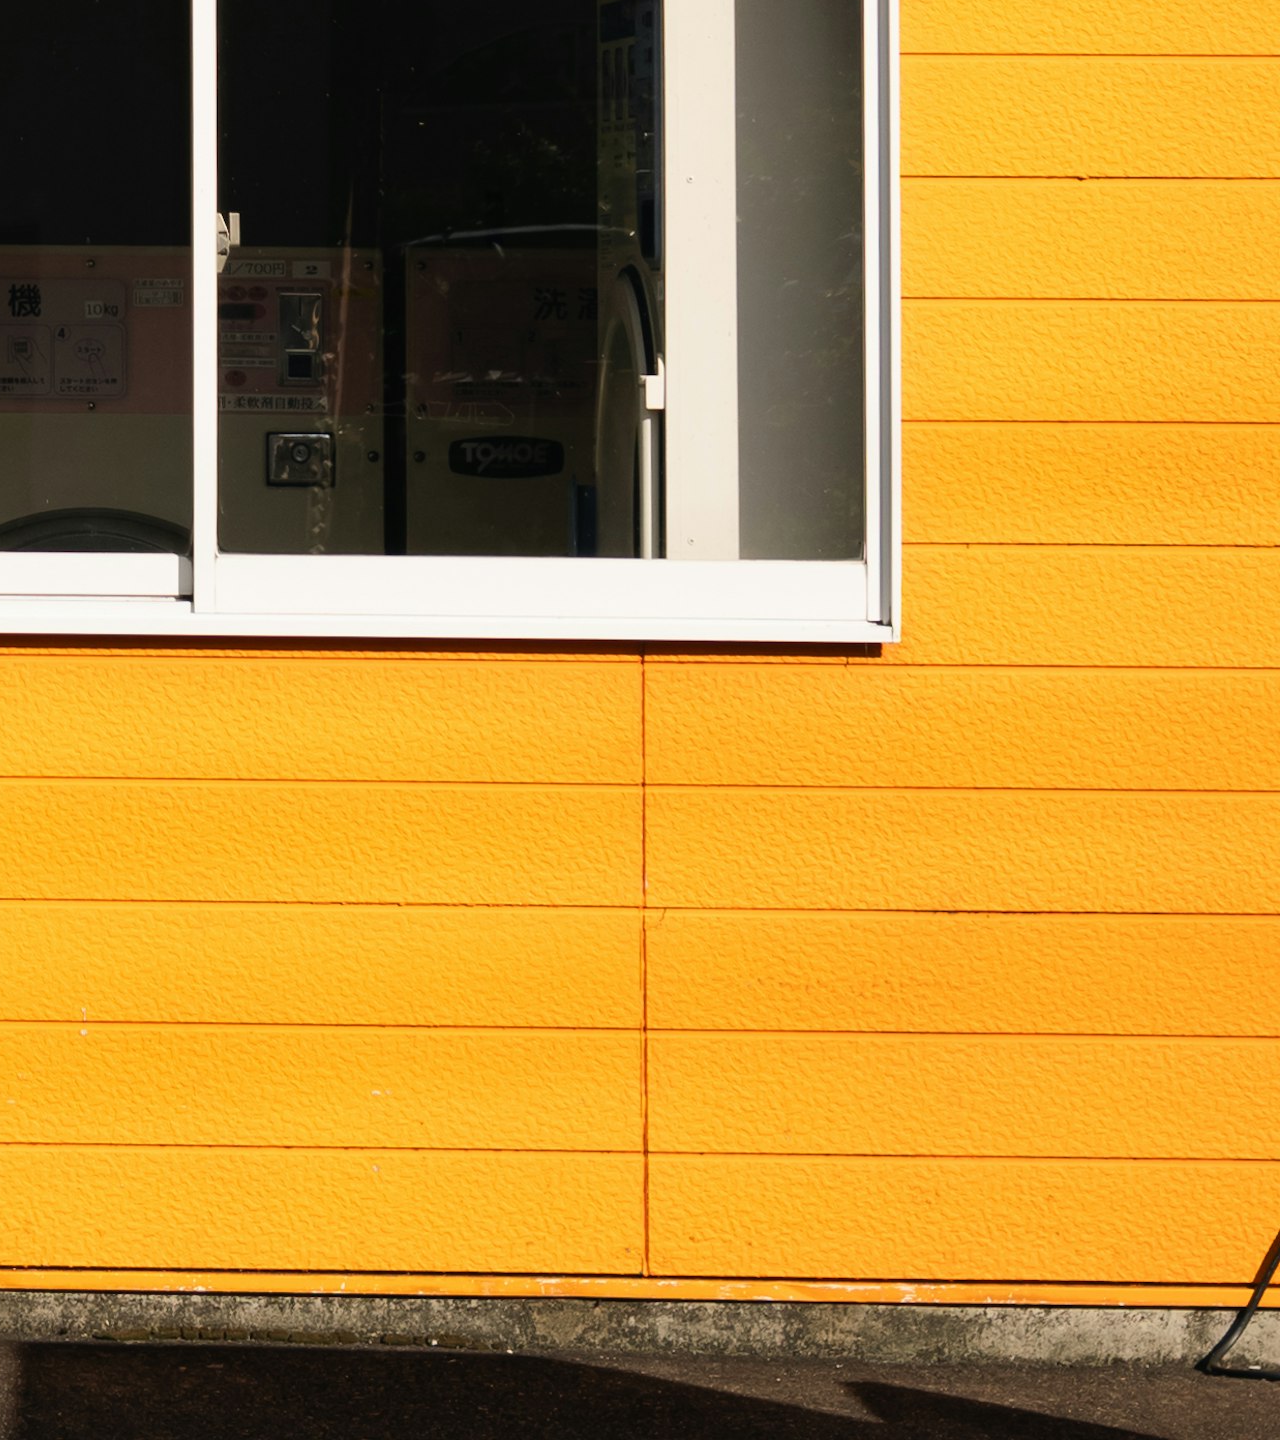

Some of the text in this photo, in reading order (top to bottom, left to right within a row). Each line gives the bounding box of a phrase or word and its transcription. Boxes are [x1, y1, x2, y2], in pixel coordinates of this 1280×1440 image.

[305, 265, 318, 274] 2
[57, 327, 65, 338] 4
[461, 443, 549, 472] TOMOE
